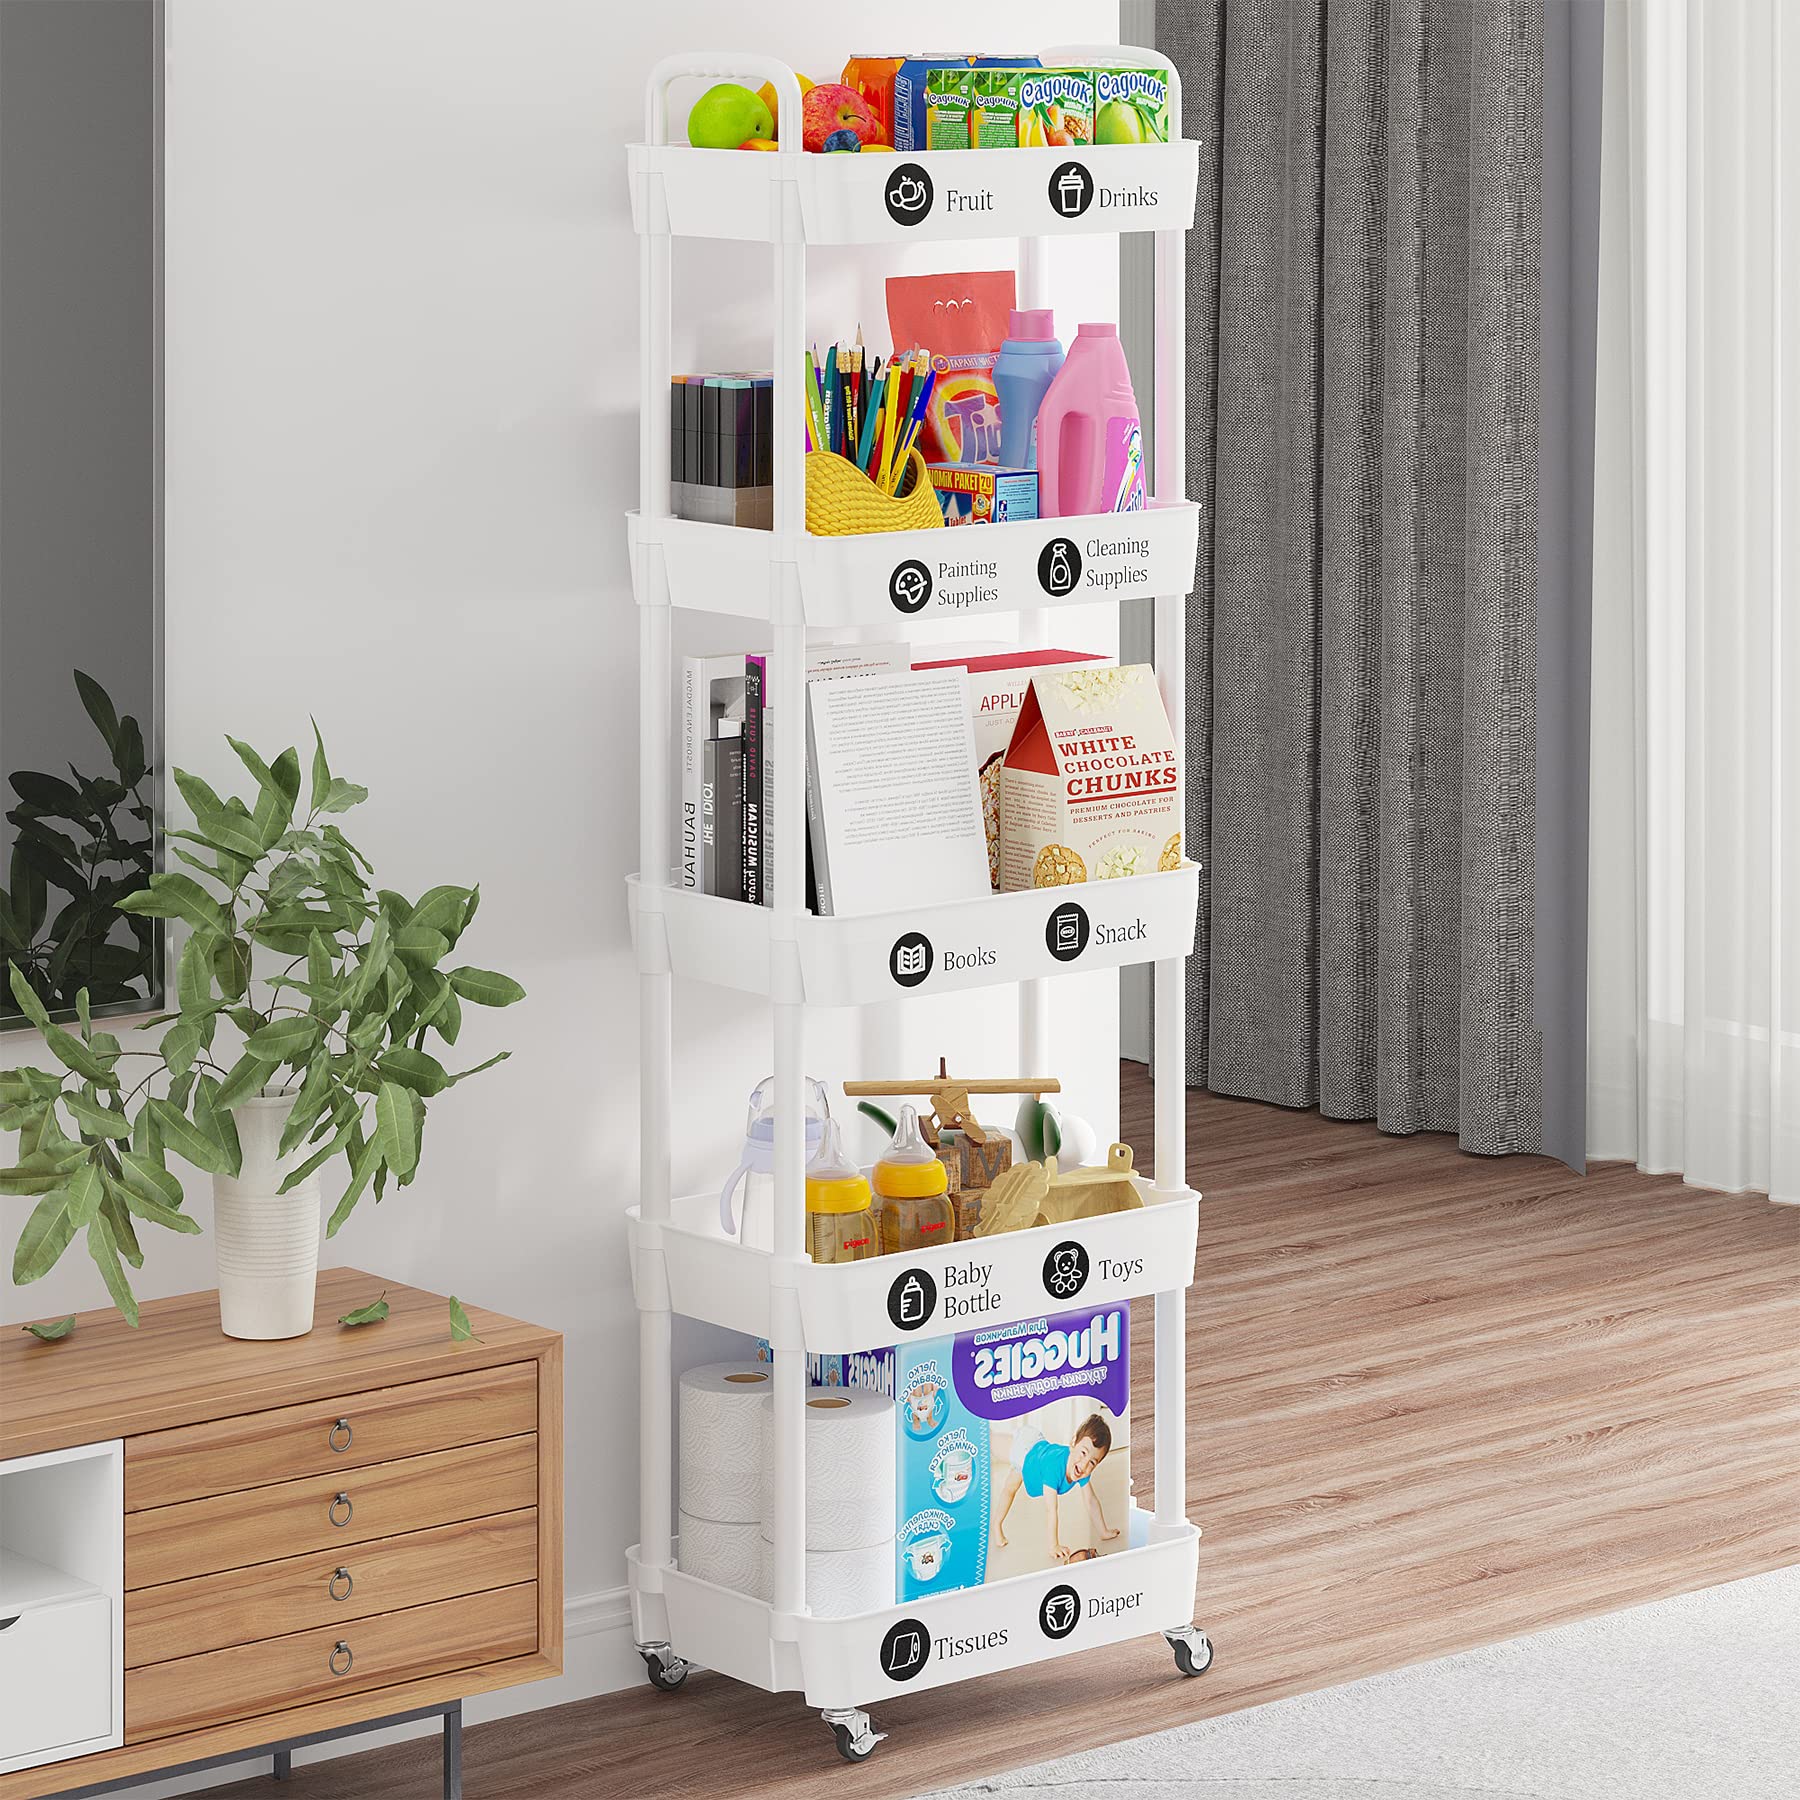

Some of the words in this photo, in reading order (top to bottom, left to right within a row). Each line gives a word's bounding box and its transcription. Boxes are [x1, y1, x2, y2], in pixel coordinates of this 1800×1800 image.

[1021, 78, 1091, 108] Садочок
[1097, 73, 1166, 101] Садочок
[929, 94, 970, 107] Садочок
[976, 95, 1018, 109] Садочок
[946, 189, 994, 212] Fruit
[1099, 186, 1158, 208] Drinks
[955, 472, 979, 491] PAKET
[980, 475, 991, 488] 70
[1086, 537, 1149, 558] Cleaning
[938, 560, 998, 580] Painting
[1086, 565, 1148, 591] Supplies
[938, 587, 998, 608] Supplies
[985, 718, 1003, 727] JUST
[1058, 735, 1137, 757] WHITE
[1064, 750, 1175, 774] CHOCOLATE
[1066, 767, 1177, 796] CHUNKS
[1070, 804, 1108, 815] PREMIUM
[1109, 799, 1157, 809] CHOCOLATE
[1158, 796, 1174, 804] FOR
[1073, 813, 1113, 824] DESSERTS
[1133, 806, 1171, 817] PASTRIES
[1088, 831, 1115, 849] PERFECT
[1133, 829, 1156, 840] BAKING
[1095, 918, 1148, 945] Snack
[944, 947, 997, 972] Books
[843, 1237, 870, 1250] pigeon
[944, 1260, 993, 1290] Baby
[1099, 1256, 1143, 1283] Toys
[944, 1289, 1001, 1320] Bottle
[1088, 1591, 1144, 1619] Diaper
[934, 1628, 1009, 1661] Tissues
